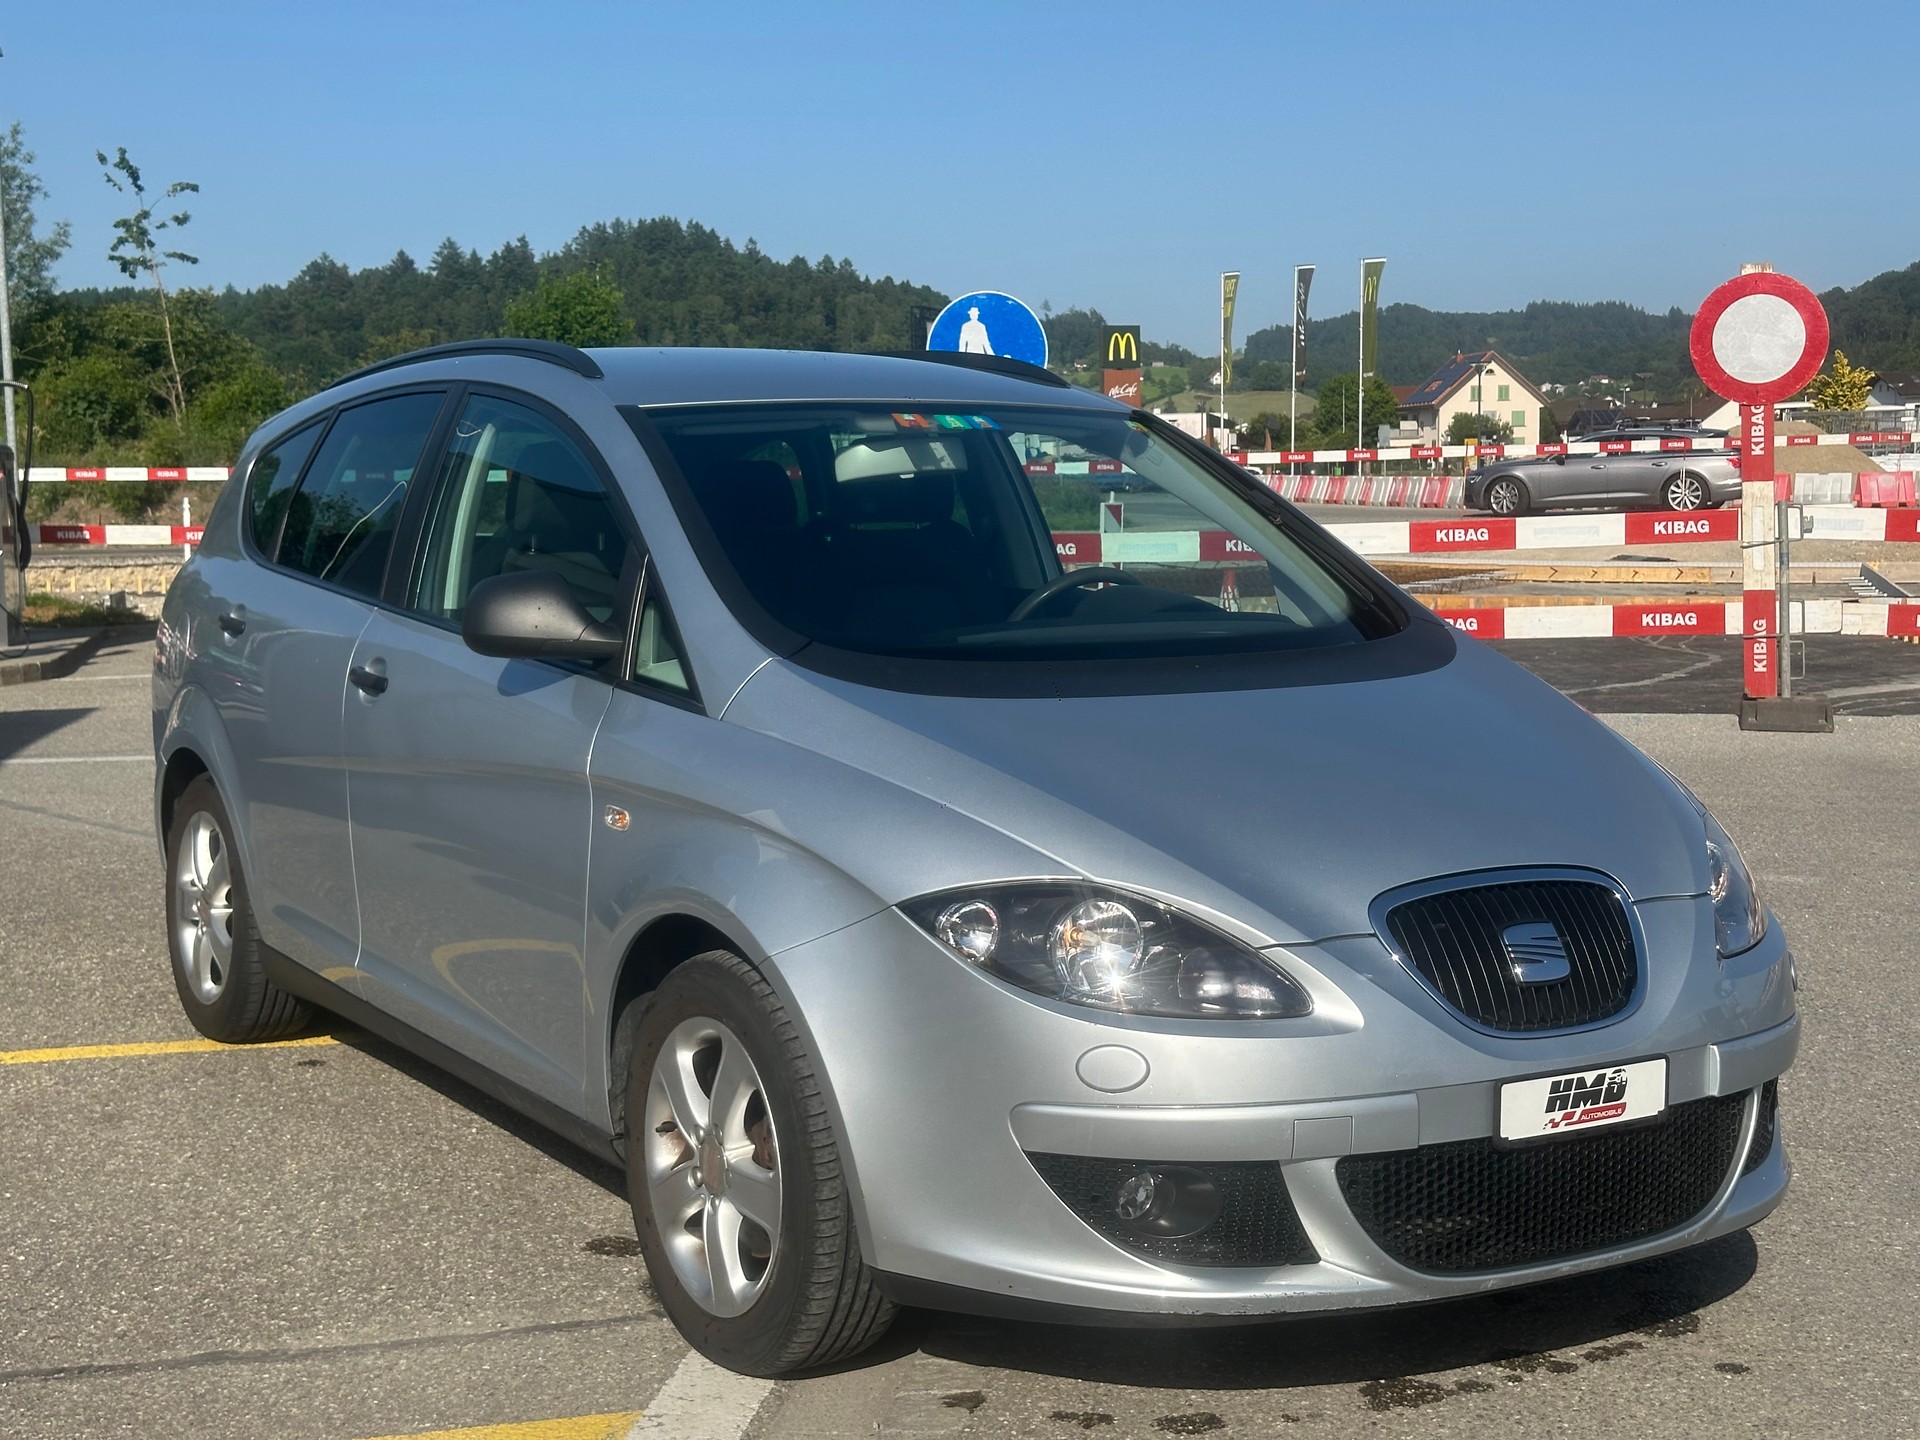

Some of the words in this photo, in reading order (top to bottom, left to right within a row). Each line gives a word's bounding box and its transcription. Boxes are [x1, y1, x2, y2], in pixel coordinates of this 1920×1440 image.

[1793, 437, 1811, 445] KIBAG
[1855, 435, 1873, 443] KIBAG
[1480, 447, 1498, 455] KIBAG
[1543, 445, 1561, 453] KIBAG
[1607, 443, 1625, 451] KIBAG
[1288, 453, 1306, 461] KIBAG
[1353, 452, 1371, 460] KIBAG
[1653, 521, 1710, 536] KIBAG
[57, 531, 91, 540] KIBAG
[1435, 528, 1489, 543] KIBAG
[1225, 540, 1256, 552] KIB
[1641, 612, 1697, 627] KIBAG
[1753, 618, 1767, 673] KIBAG
[1581, 1108, 1622, 1120] AUTOMOBILE
